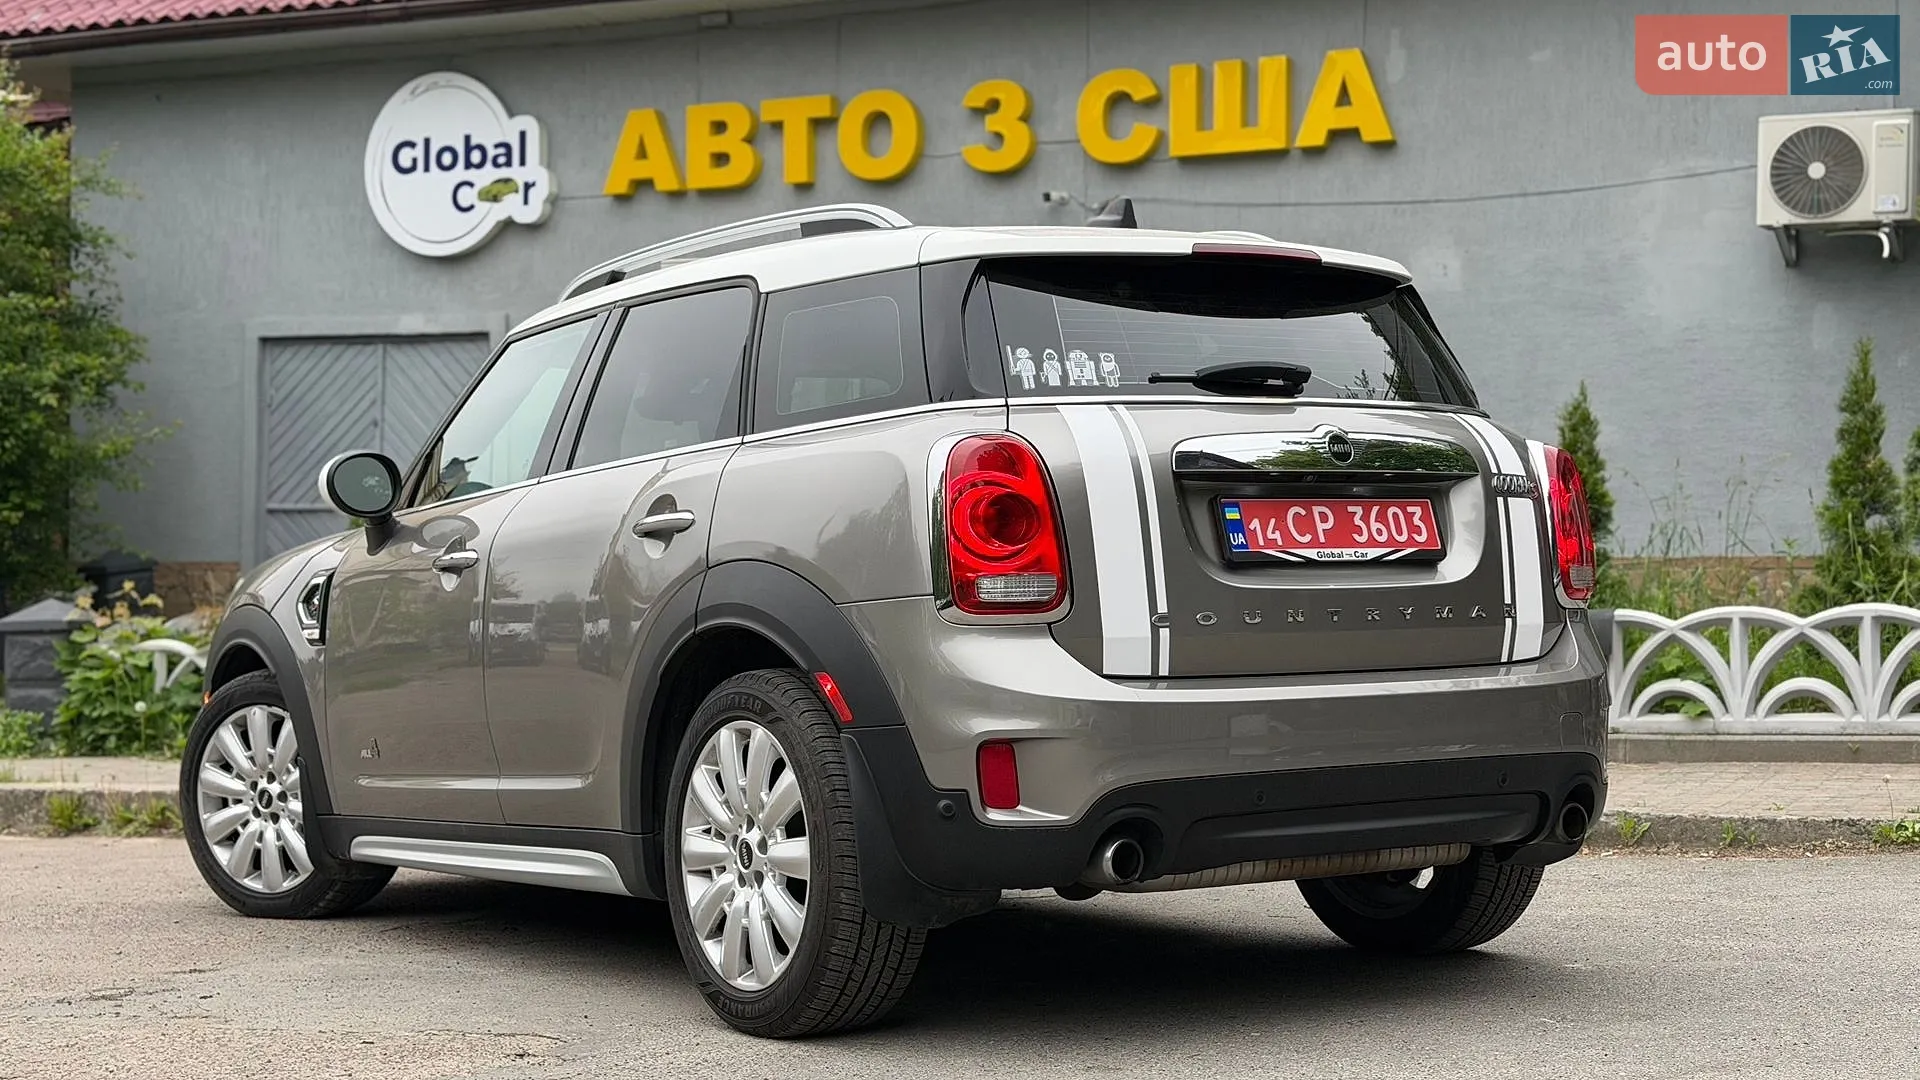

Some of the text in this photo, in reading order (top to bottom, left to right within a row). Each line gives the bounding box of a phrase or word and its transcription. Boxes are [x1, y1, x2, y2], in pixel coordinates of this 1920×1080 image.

[603, 88, 926, 196] АВТО
[1077, 47, 1397, 165] США
[391, 130, 527, 175] Global
[452, 177, 536, 213] Cr
[1229, 532, 1247, 545] UA
[1346, 505, 1428, 544] 3603
[1316, 550, 1369, 559] Global Car
[1151, 604, 1517, 627] COUNTRYMAN
